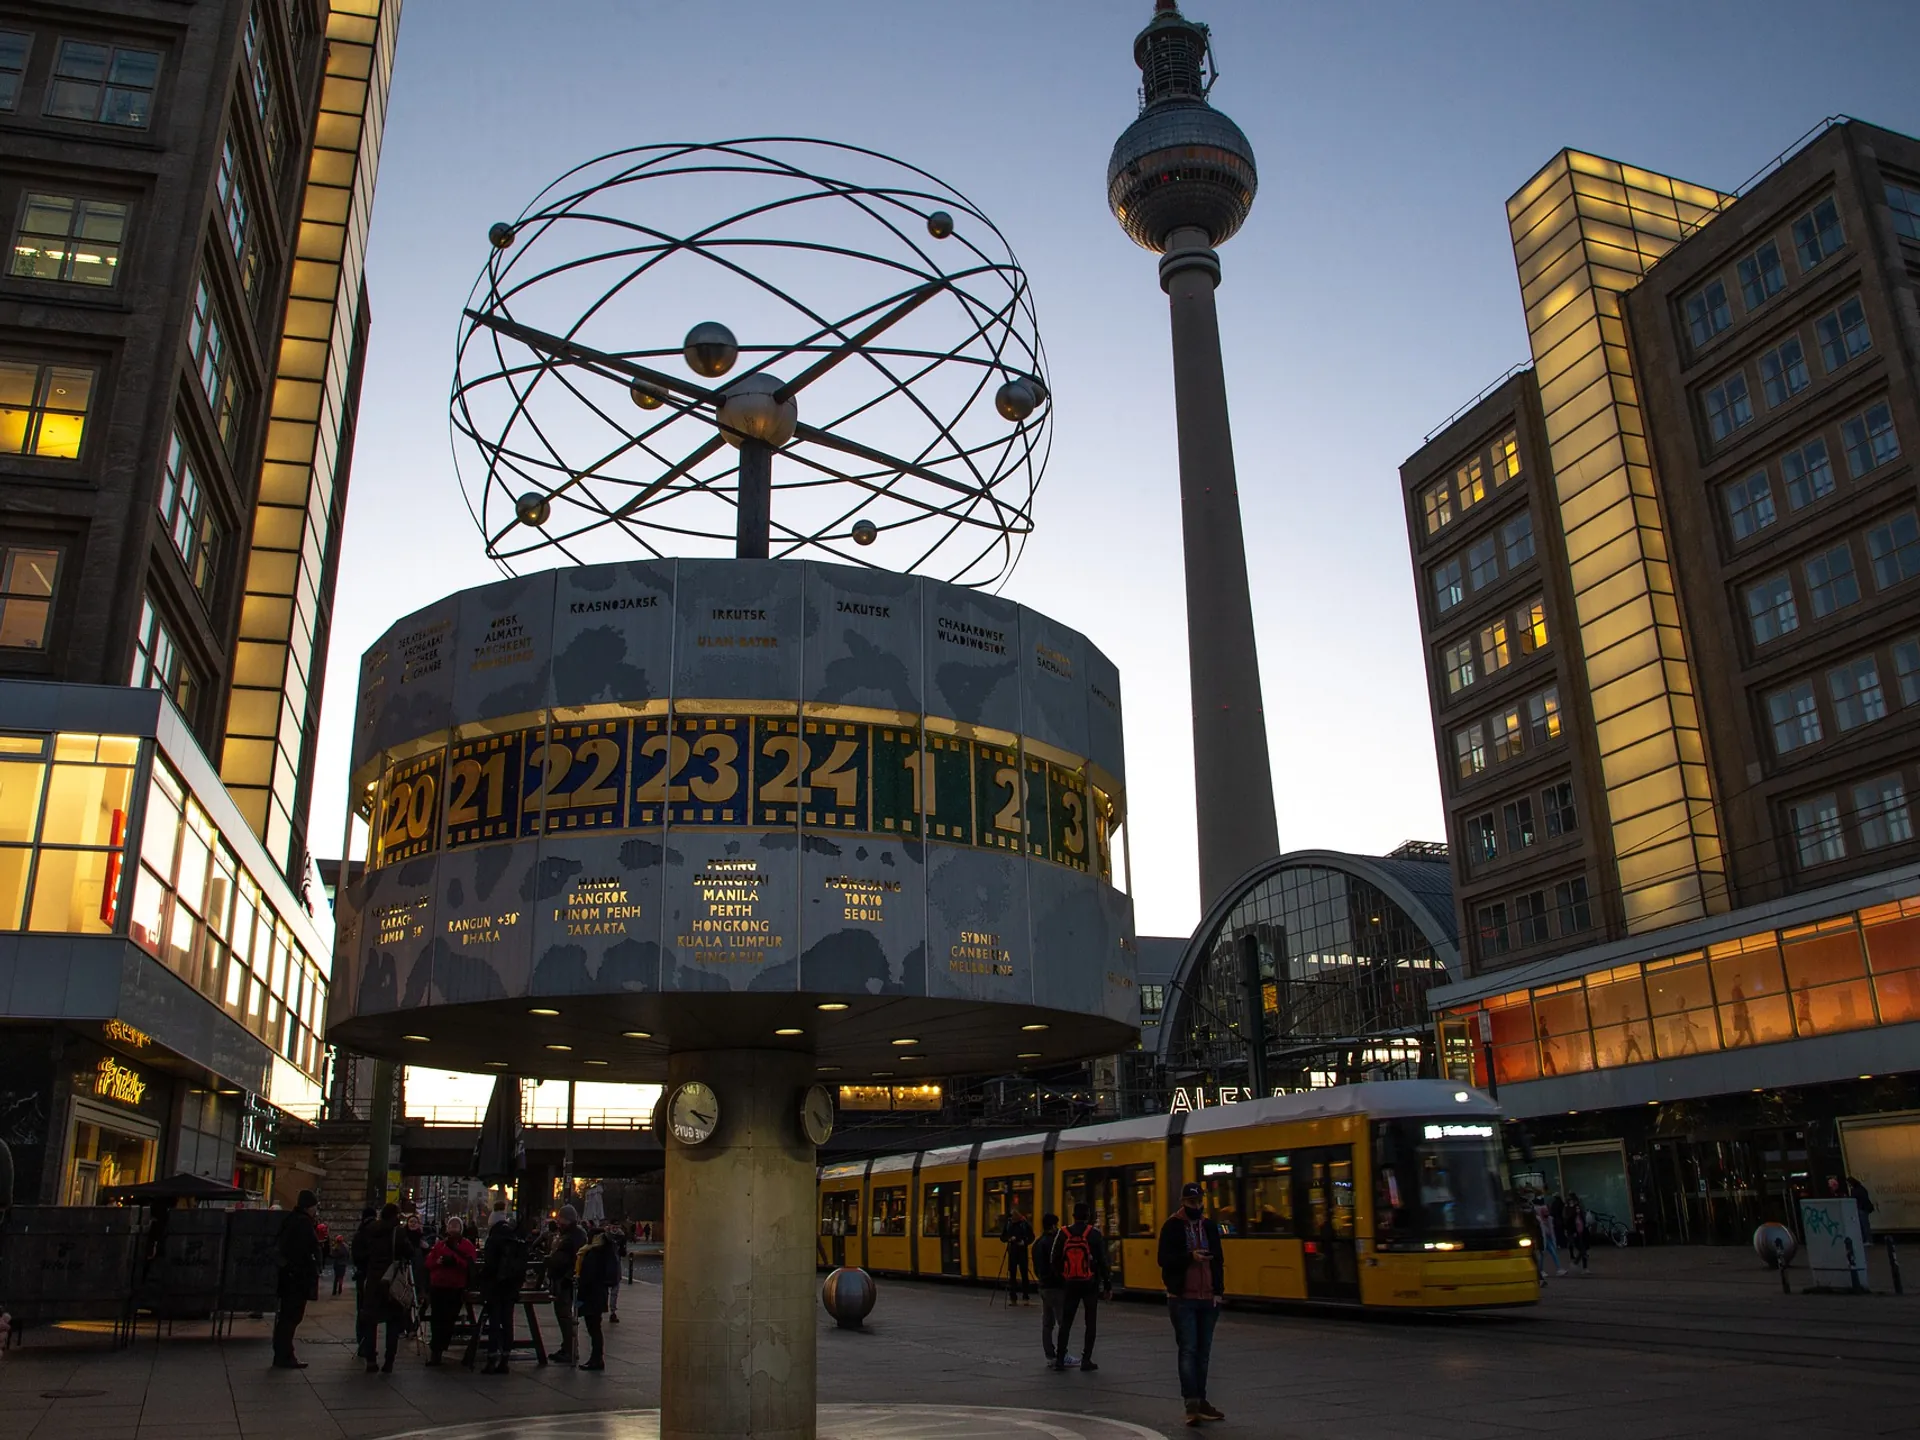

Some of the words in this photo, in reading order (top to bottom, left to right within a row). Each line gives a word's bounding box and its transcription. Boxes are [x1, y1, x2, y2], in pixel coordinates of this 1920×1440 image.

[570, 596, 657, 615] KRASNOJARSK
[837, 601, 890, 619] JAKUTSK
[491, 614, 517, 628] OMSK
[713, 609, 766, 621] IRKUTSK
[484, 624, 524, 644] ALMATY
[938, 617, 1005, 642] CHABAROWSK
[937, 630, 1007, 656] WLADIWOSTOK
[384, 774, 435, 849] 20
[449, 752, 506, 826] 21
[524, 737, 620, 813] 22
[637, 732, 739, 803] 23
[759, 735, 860, 807] 24
[903, 751, 936, 816] 1
[994, 768, 1031, 834] 2
[1062, 791, 1084, 854] 3
[577, 876, 620, 890] HANOI
[693, 874, 769, 886] SHANGHAI
[567, 890, 628, 906] BANGKOK
[703, 889, 760, 901] MANILA
[844, 892, 882, 907] TOKYO
[606, 905, 641, 919] PENH
[709, 904, 753, 917] PERTH
[844, 908, 884, 922] SEOUL
[380, 913, 415, 931] KARACHI
[448, 916, 491, 934] RANGUN
[567, 922, 626, 936] JAKARTA
[692, 920, 769, 932] HONGKONG
[462, 930, 501, 946] DHAKA
[676, 935, 723, 948] KUALA
[729, 935, 783, 948] LUMPUR
